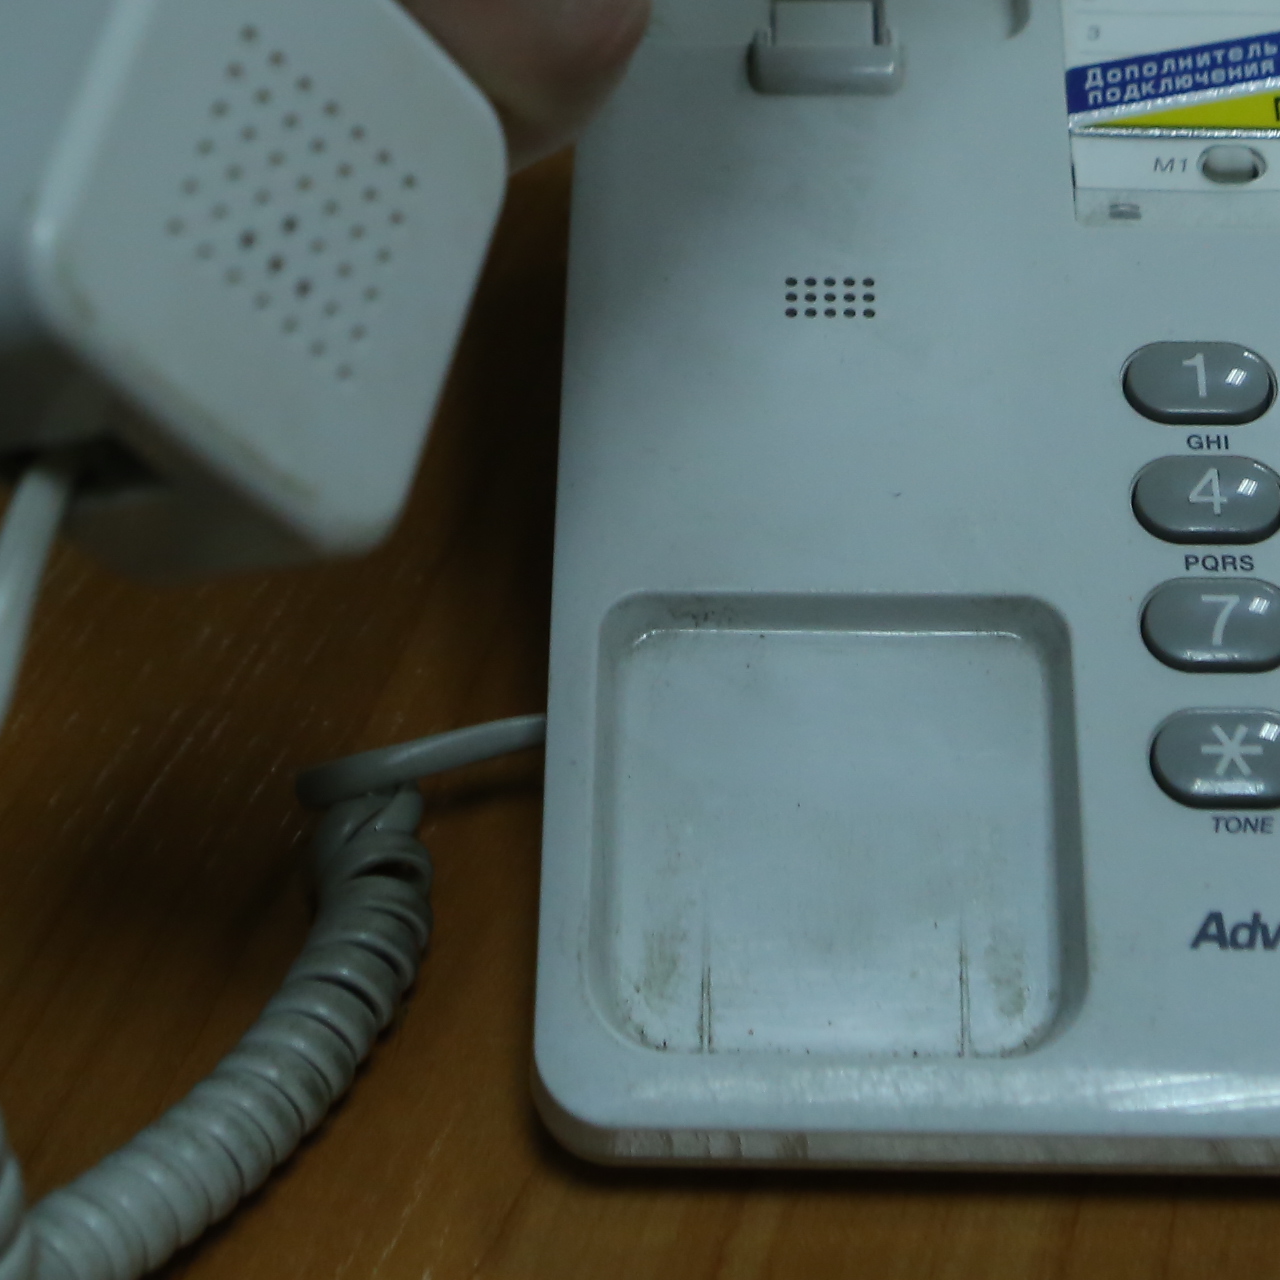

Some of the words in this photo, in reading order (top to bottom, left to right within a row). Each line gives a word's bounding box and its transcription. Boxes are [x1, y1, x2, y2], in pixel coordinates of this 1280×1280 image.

[1087, 57, 1276, 107] подключения
[1152, 156, 1189, 174] M1
[1180, 353, 1209, 398] 1
[1185, 433, 1231, 451] GHI
[1188, 468, 1228, 517] 4
[1183, 554, 1255, 574] PQRS
[1199, 593, 1241, 647] 7
[1211, 815, 1274, 835] TONE
